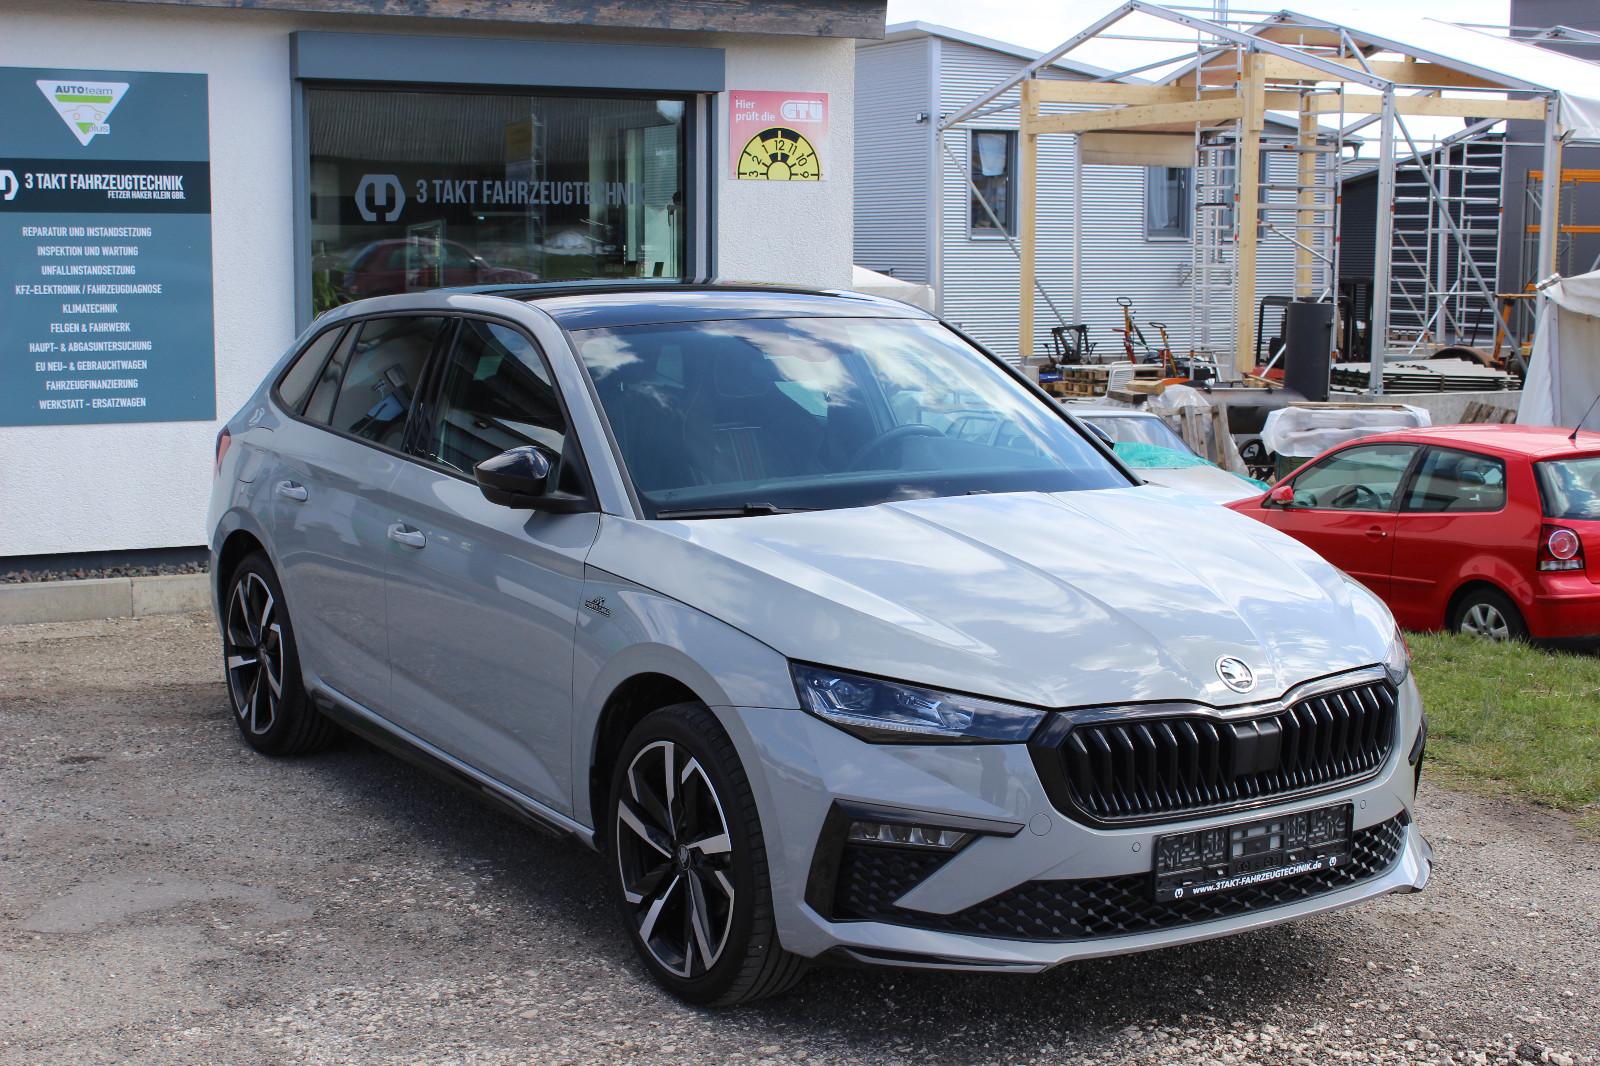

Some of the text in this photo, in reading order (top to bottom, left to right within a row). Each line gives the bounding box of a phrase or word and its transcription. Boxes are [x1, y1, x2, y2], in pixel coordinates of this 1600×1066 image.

[735, 99, 755, 109] Hier
[735, 111, 776, 123] prüft die
[774, 139, 785, 151] 12
[788, 143, 798, 155] 11
[796, 152, 808, 167] 10
[24, 173, 184, 191] 3 TAKT FAHRZEUGTECHNIK
[107, 190, 131, 199] FETZER
[131, 190, 153, 200] HAKER
[153, 191, 171, 200] KLEIN
[415, 179, 428, 204] 3
[432, 179, 478, 204] TAKT
[22, 226, 152, 237] REPARATUR UND INSTANDSETZUNG
[37, 246, 139, 257] INSPEKTION UND WARTUNG
[41, 265, 136, 276] UNFALLINSTANDSETZUNG
[15, 284, 81, 295] KFZ-ELEKTRONIK
[87, 284, 163, 294] FAHRZEUGDIAGNOSE
[62, 303, 118, 314] KLIMATECHNIK
[50, 322, 131, 333] FELGEN & FAHRWERK
[29, 341, 152, 353] HAUPT- & ABGASUNTERSUCHUNG
[35, 360, 148, 372] EU NEU- & GEBRAUCHTWAGEN
[46, 379, 139, 390] FAHRZEUGFINANZIERUNG
[39, 399, 84, 410] WERKSTATT
[92, 398, 146, 409] ERSATZWAGEN
[1192, 861, 1322, 895] www.3TAKT-FAHRZEUGTECHNIK.de
